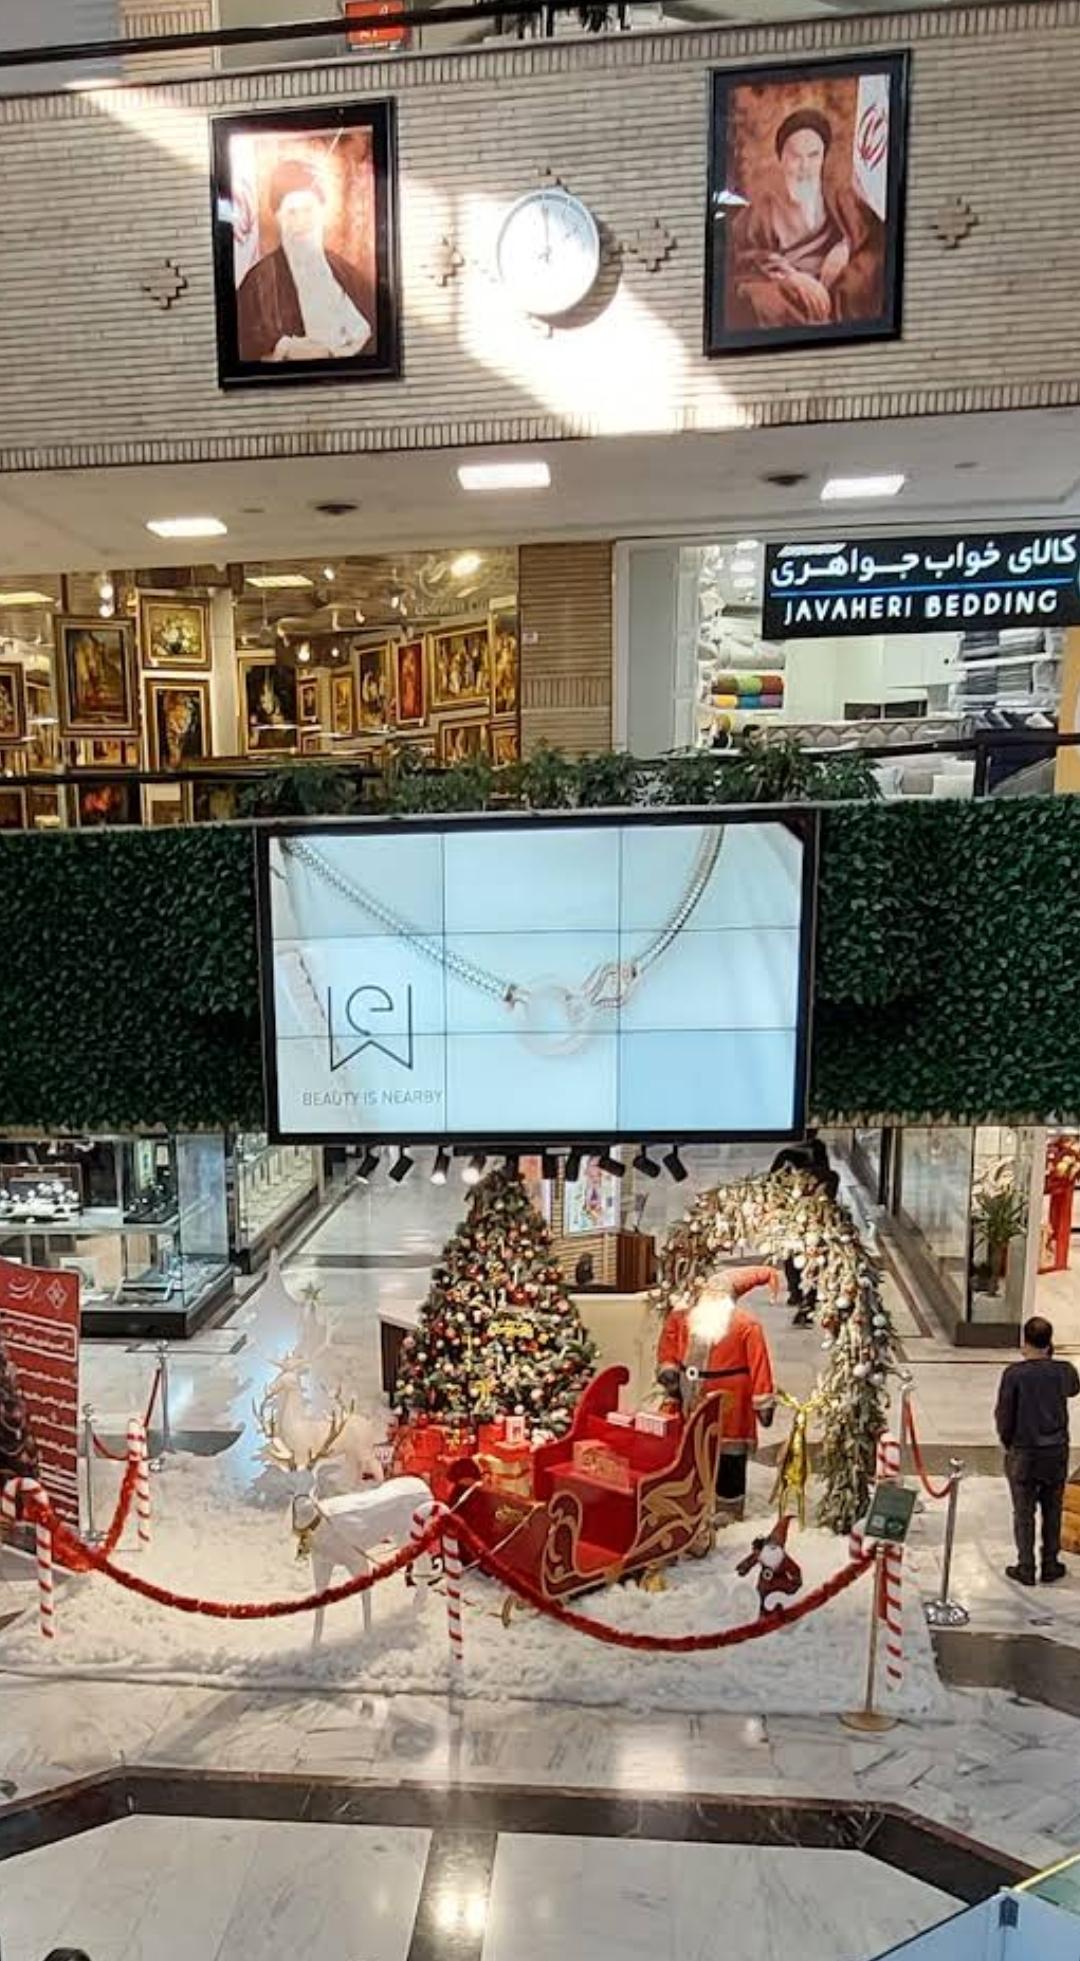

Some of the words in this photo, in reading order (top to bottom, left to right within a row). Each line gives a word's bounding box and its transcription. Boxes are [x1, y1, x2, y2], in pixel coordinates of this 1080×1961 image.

[771, 548, 920, 587] جواهری
[925, 541, 1000, 578] خواب
[1007, 535, 1077, 573] کالای
[784, 595, 912, 625] JAVAHERI
[925, 589, 1058, 618] BEDDING
[302, 1090, 360, 1106] BEAUTY
[364, 1090, 378, 1105] IS
[381, 1089, 443, 1104] NEARBY
